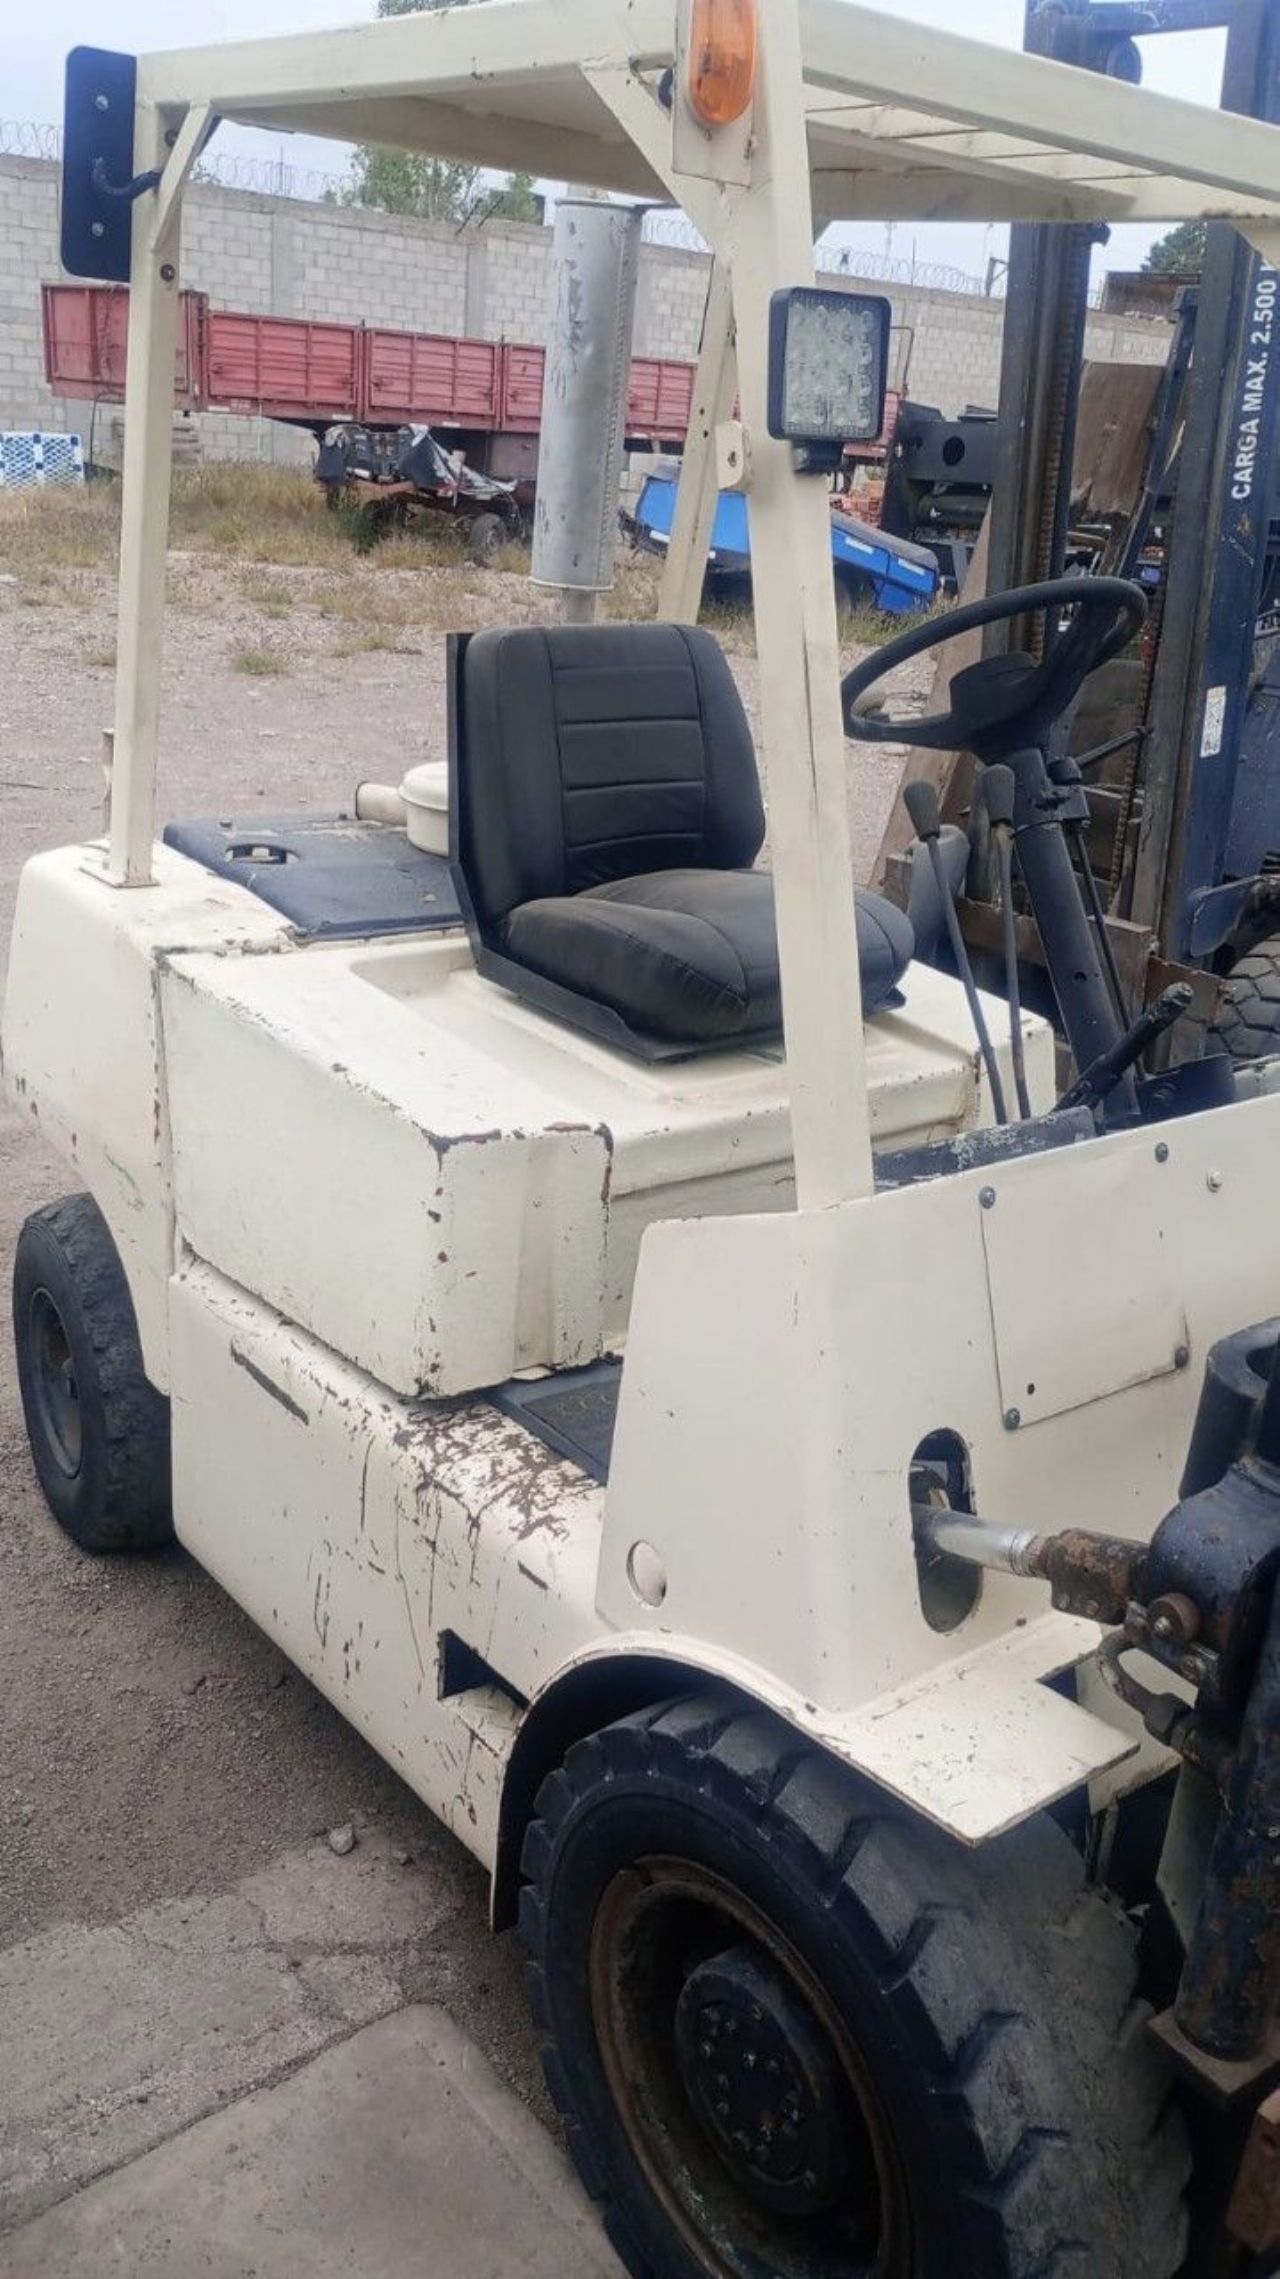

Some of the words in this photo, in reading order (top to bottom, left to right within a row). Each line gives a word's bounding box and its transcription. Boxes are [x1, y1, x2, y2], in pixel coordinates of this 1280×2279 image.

[1252, 279, 1278, 345] 2.500
[1242, 352, 1269, 413] MAX.
[1231, 418, 1260, 501] CARGA
